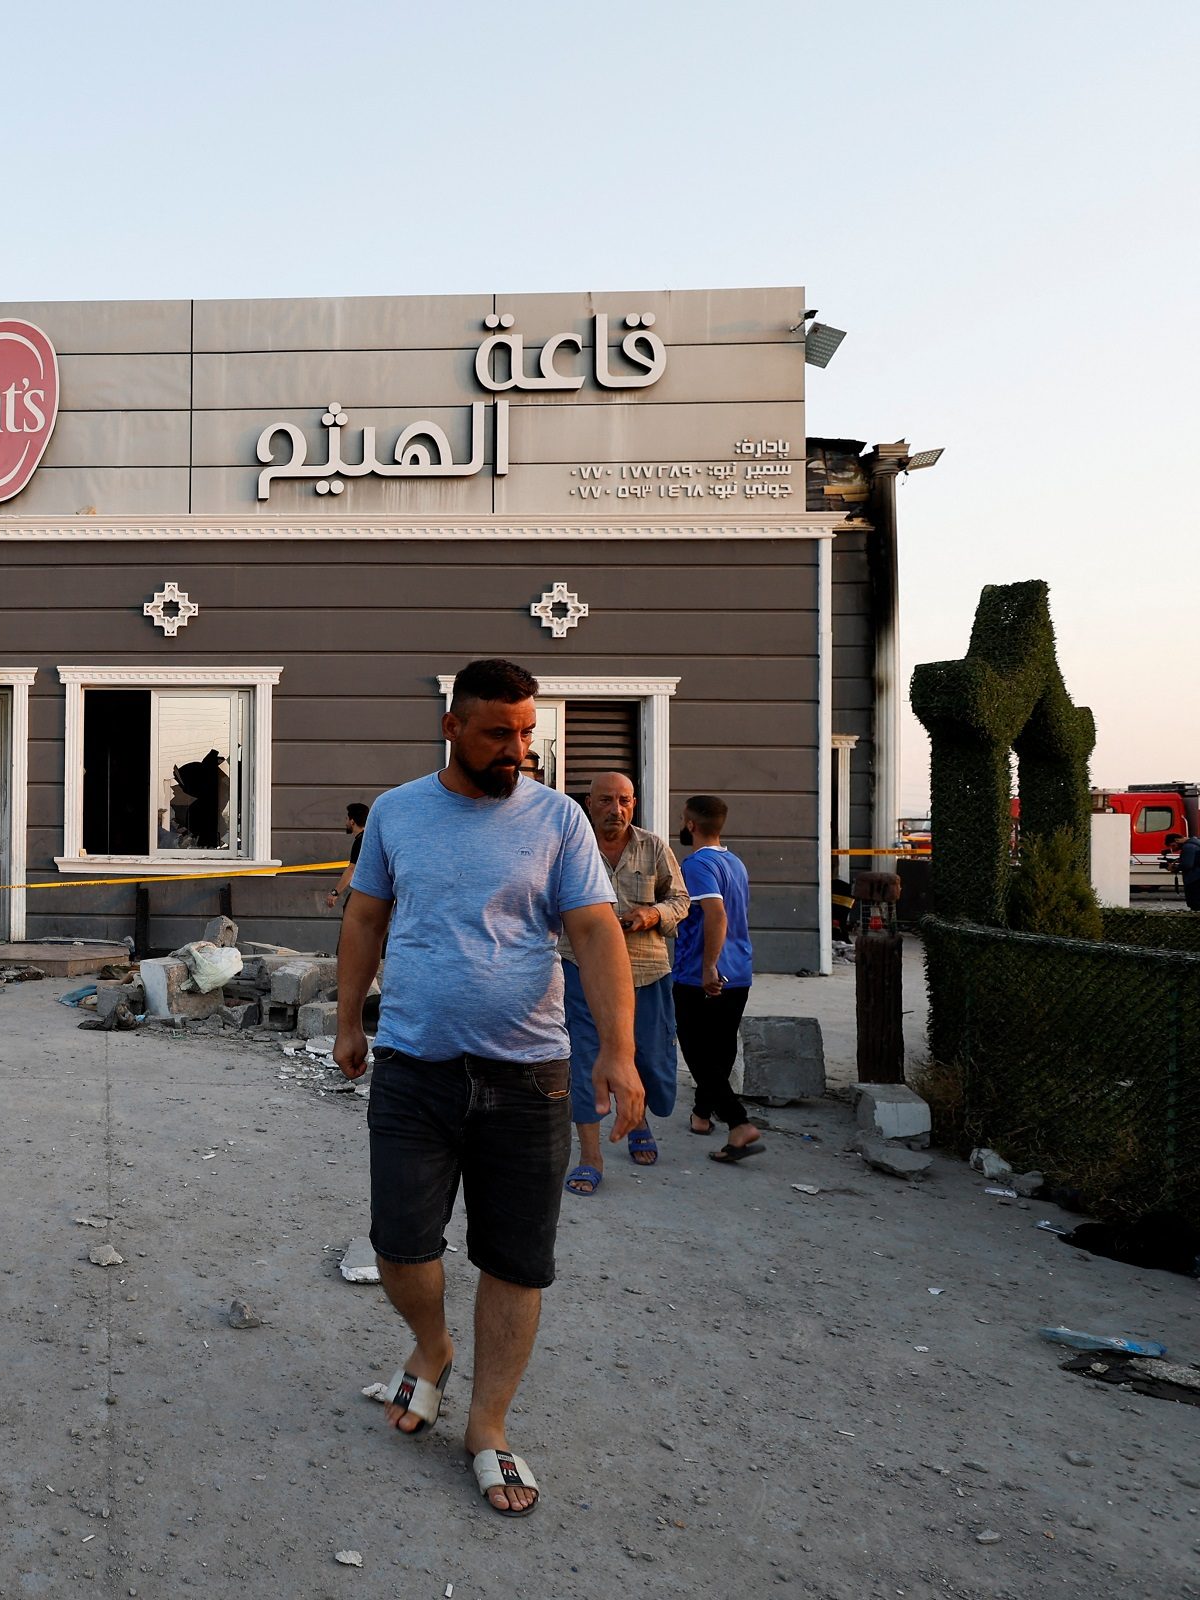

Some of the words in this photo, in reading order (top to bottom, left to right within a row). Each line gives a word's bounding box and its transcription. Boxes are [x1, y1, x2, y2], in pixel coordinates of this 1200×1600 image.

[475, 312, 667, 391] قاعة
[256, 400, 510, 500] الهيثم
[745, 464, 792, 480] سمير
[744, 481, 794, 499] جوني
